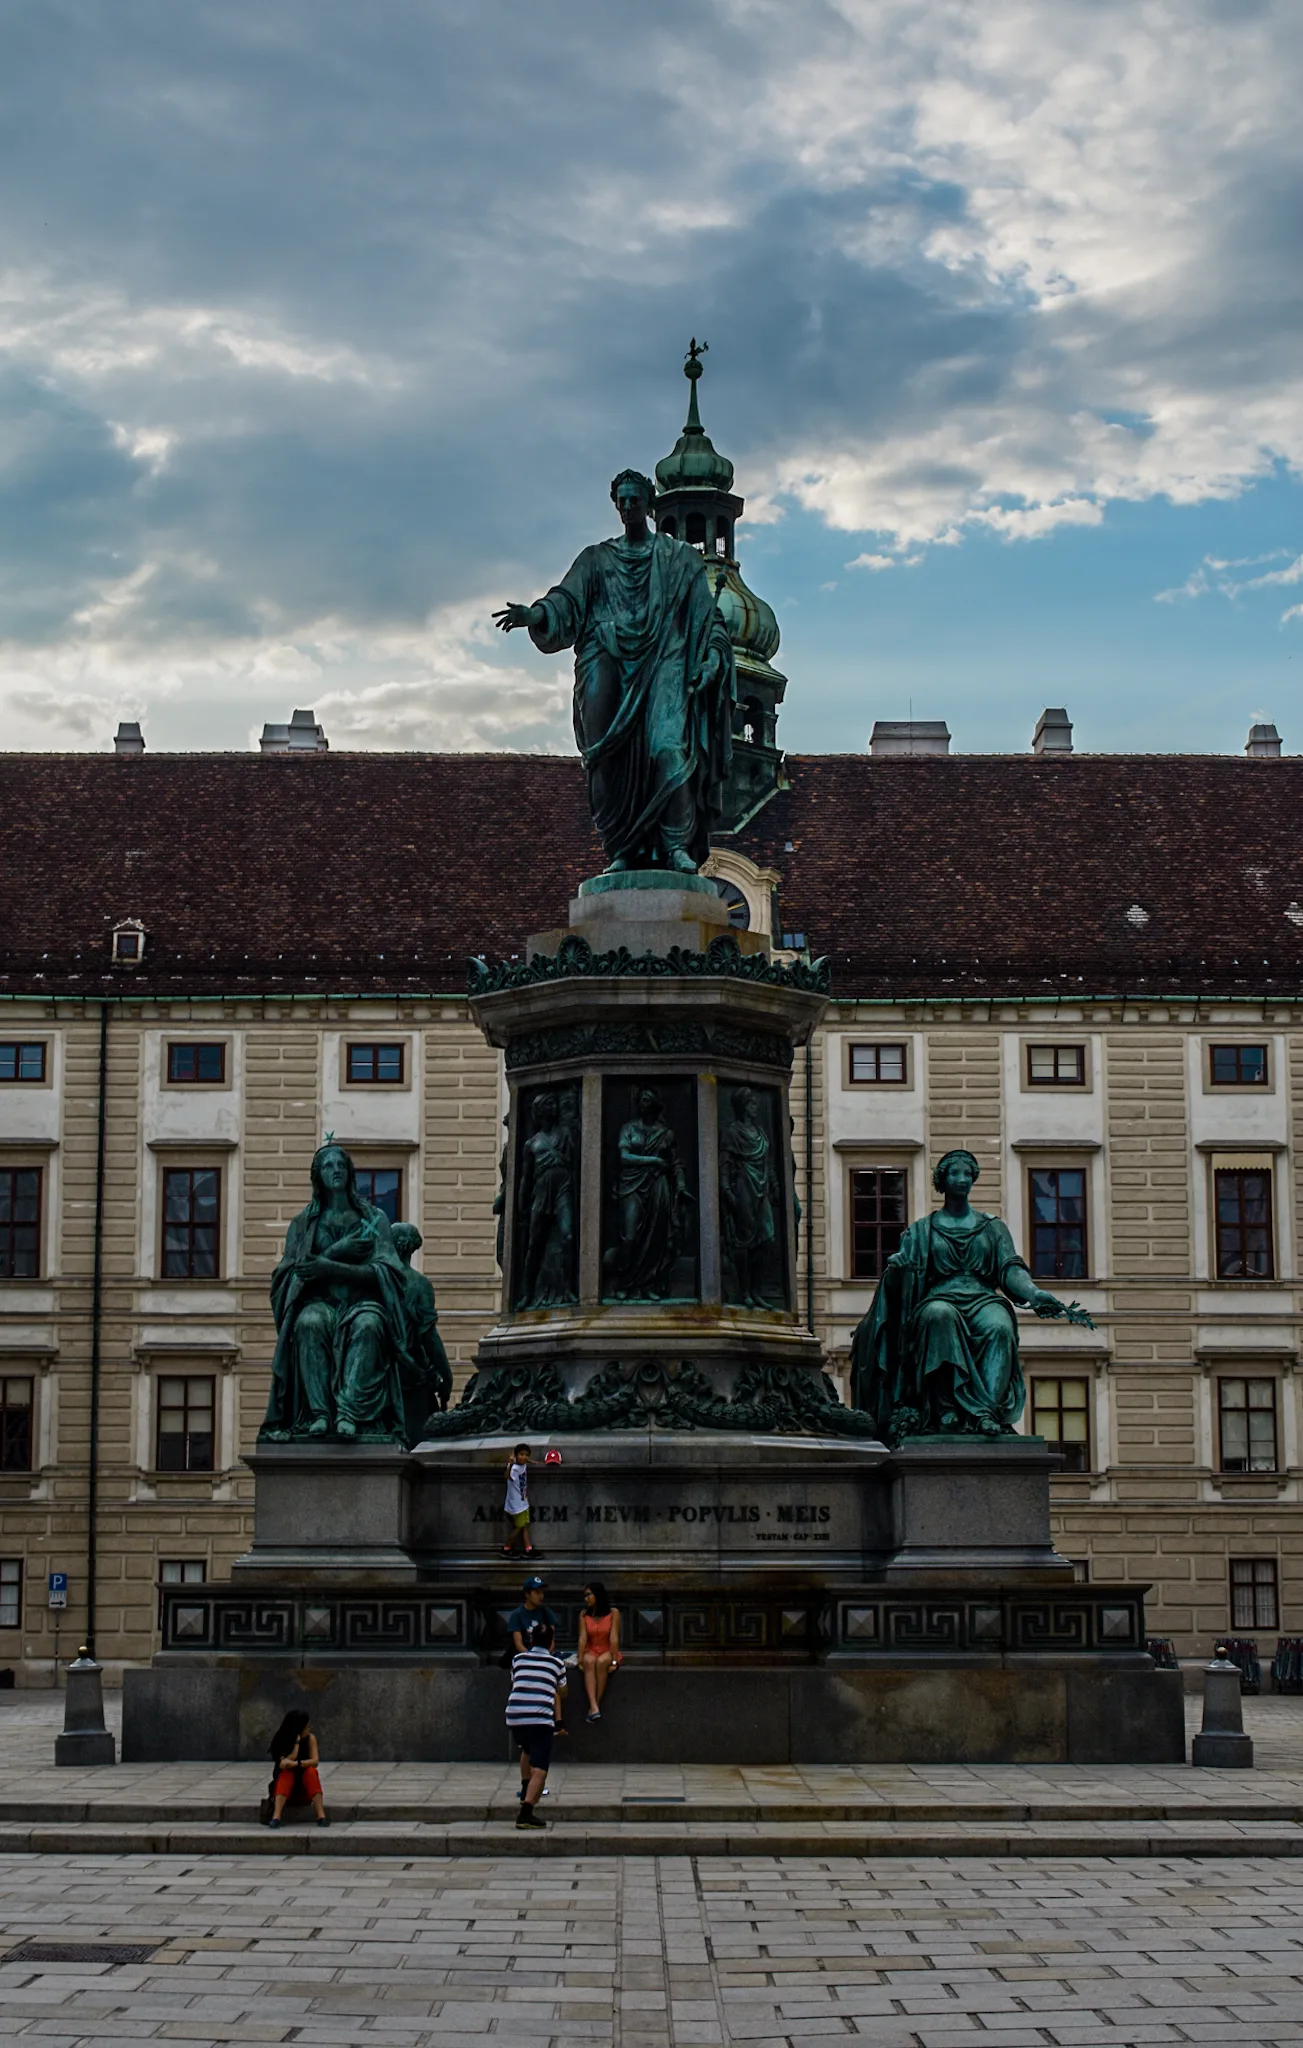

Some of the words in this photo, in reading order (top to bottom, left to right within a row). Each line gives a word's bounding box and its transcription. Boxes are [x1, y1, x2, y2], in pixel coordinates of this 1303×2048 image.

[472, 1505, 568, 1523] AMREM
[586, 1505, 650, 1523] MEVM
[668, 1505, 760, 1523] POPVLIS
[777, 1505, 830, 1523] MEIS
[52, 1575, 63, 1590] P
